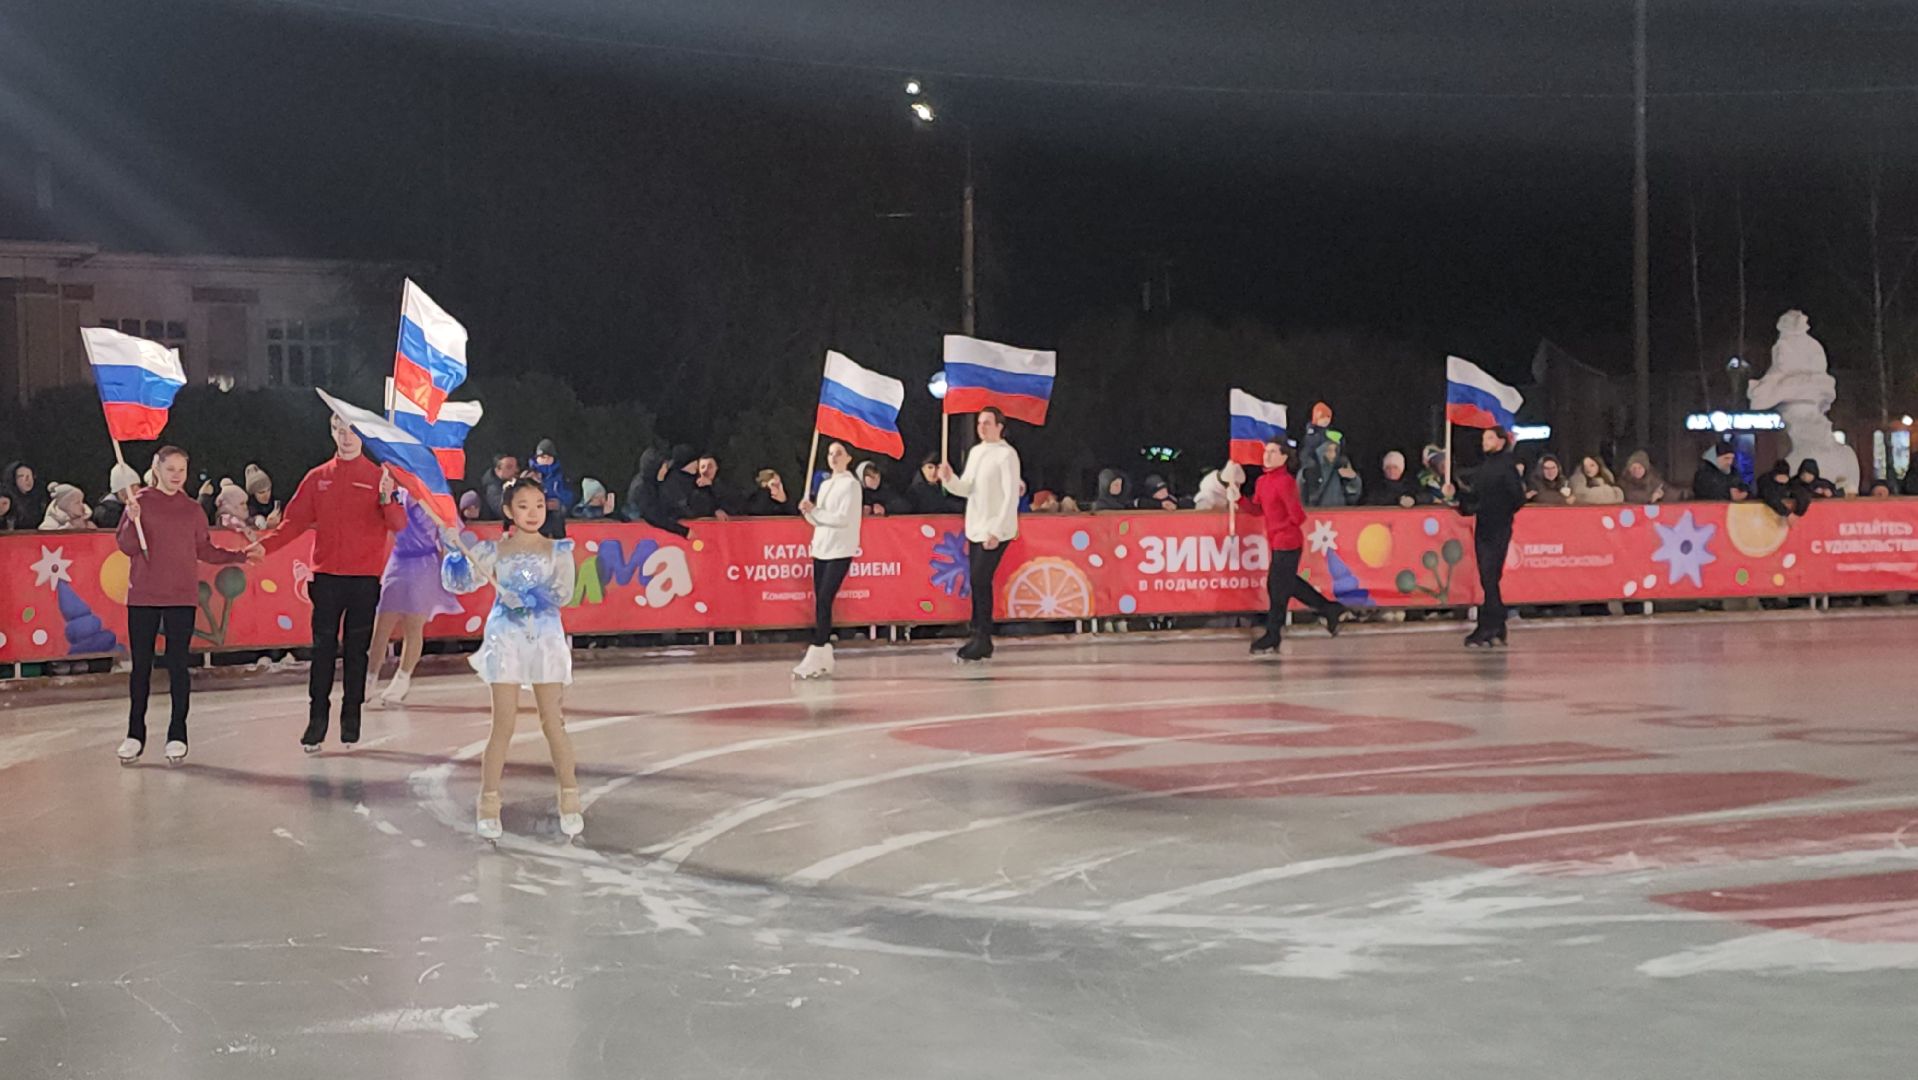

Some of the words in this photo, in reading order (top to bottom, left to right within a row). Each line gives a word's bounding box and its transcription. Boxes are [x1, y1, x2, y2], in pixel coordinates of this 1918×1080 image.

[1810, 540, 1823, 554] С
[727, 565, 740, 581] С
[744, 562, 901, 581] УДОВОЛВИЕМ!
